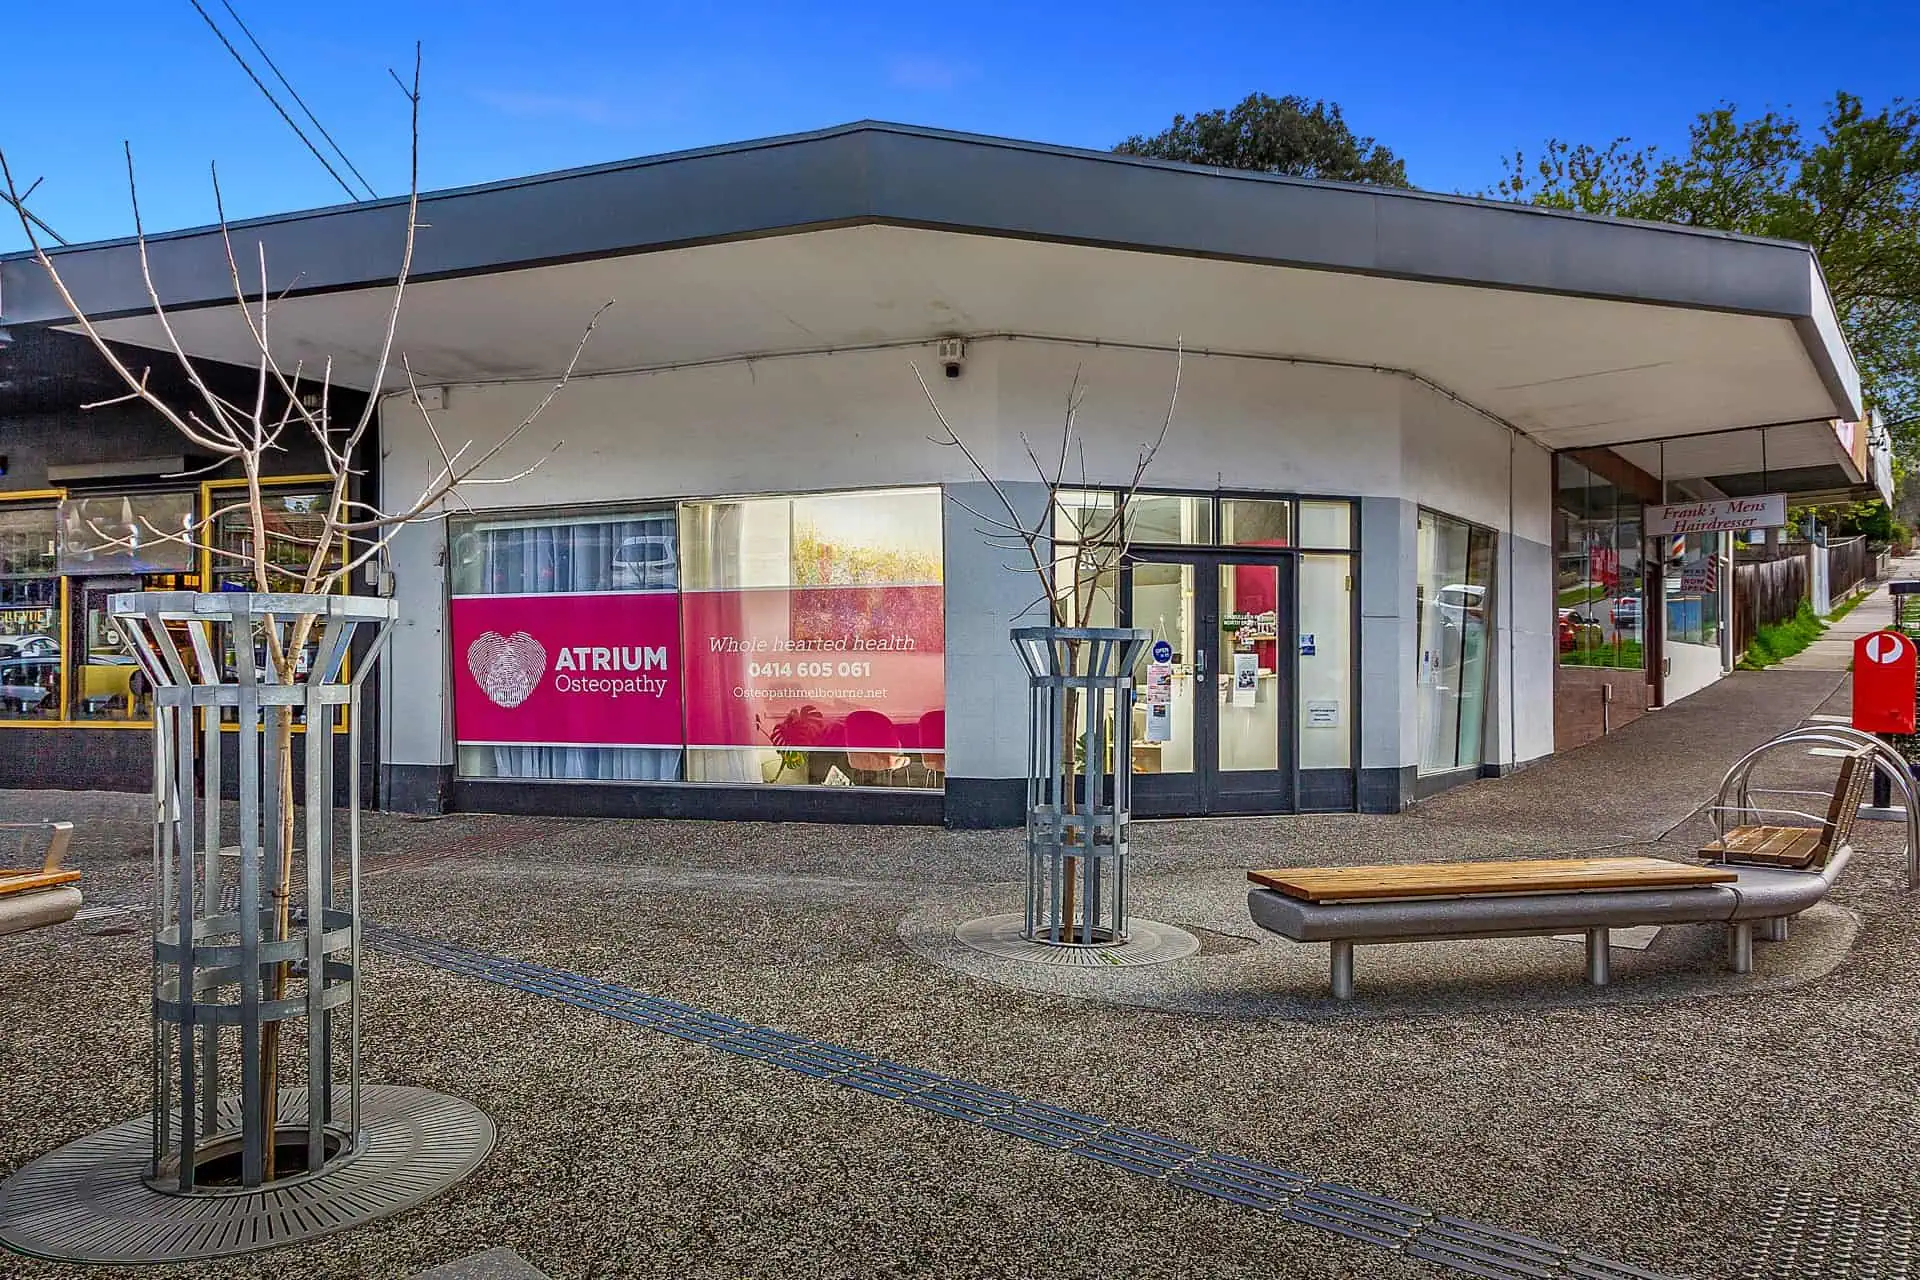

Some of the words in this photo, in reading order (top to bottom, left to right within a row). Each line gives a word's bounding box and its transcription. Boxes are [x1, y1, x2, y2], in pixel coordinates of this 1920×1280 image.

[1663, 503, 1717, 520] Frank's
[1725, 500, 1768, 514] Mens
[1672, 516, 1757, 533] Hairdresser
[709, 636, 768, 653] Whole
[773, 634, 847, 652] hearted
[852, 634, 915, 651] health
[555, 646, 668, 671] ATRIUM
[749, 662, 792, 678] 0414
[797, 662, 833, 677] 605
[838, 662, 871, 677] 061
[555, 674, 668, 698] Osteopathy
[733, 686, 888, 700] Osteopathmelbourne.net
